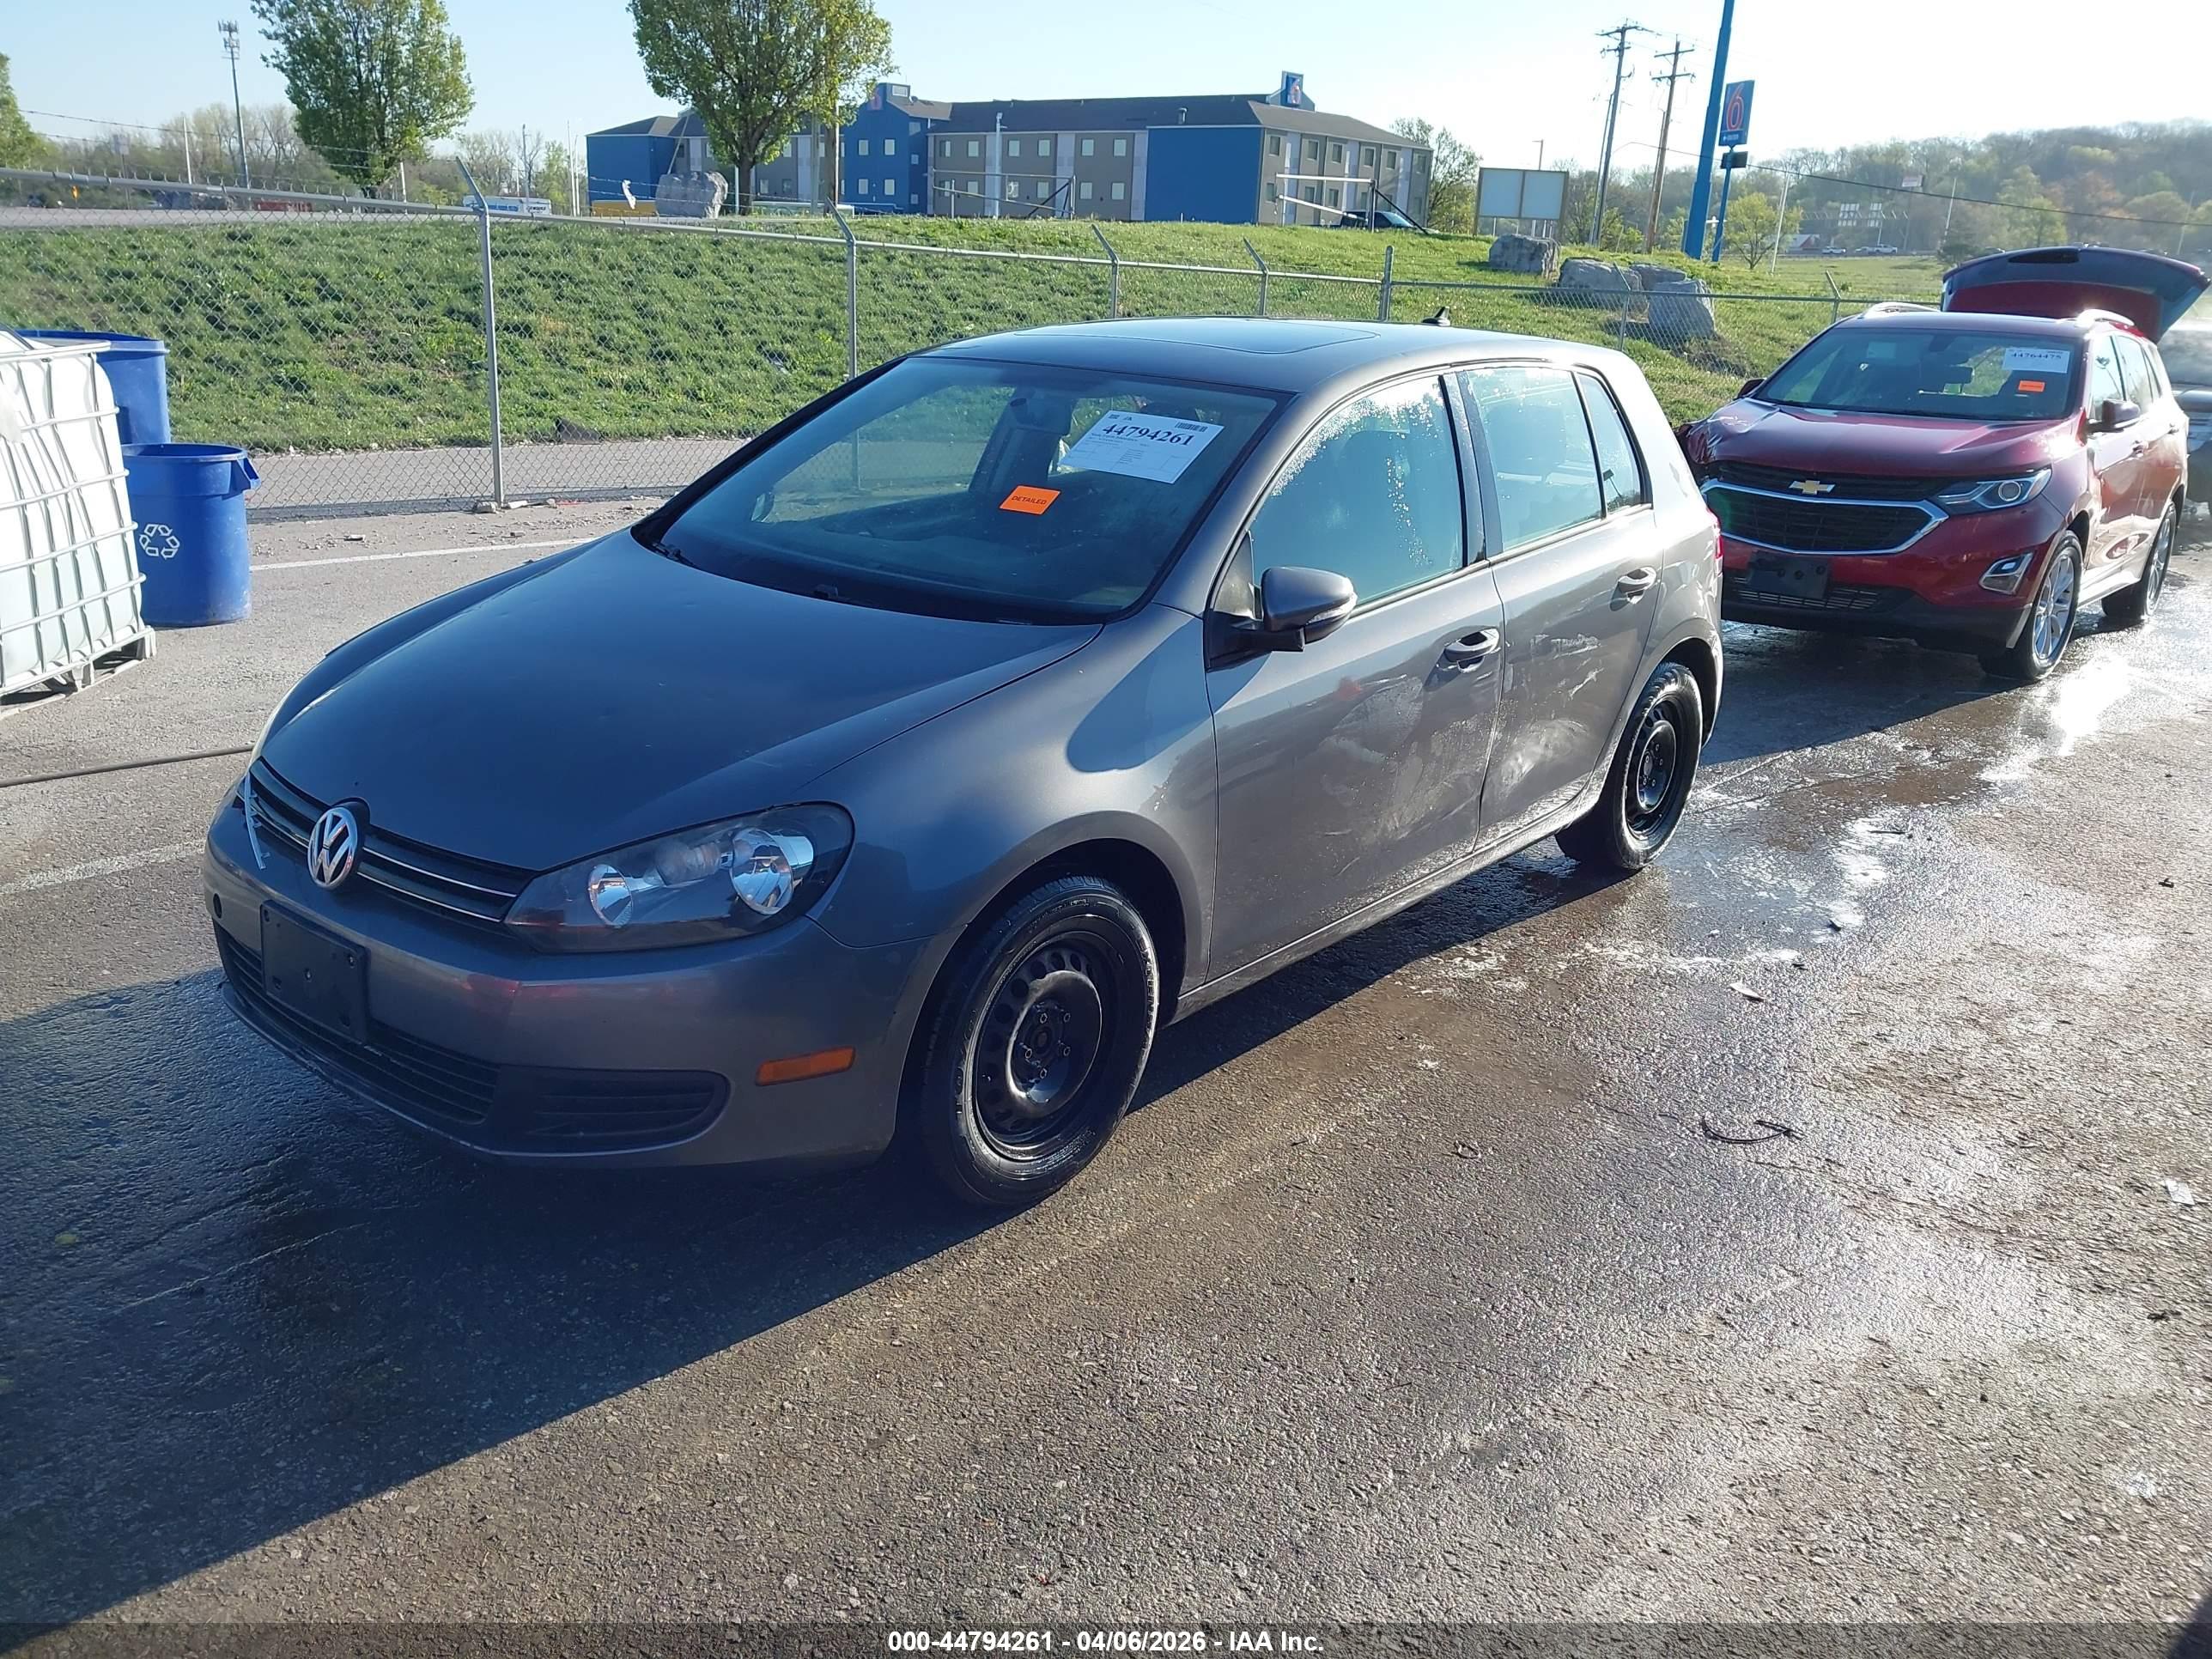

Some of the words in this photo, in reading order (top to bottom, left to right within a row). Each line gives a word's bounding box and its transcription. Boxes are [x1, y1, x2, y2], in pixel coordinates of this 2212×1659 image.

[1726, 82, 1744, 131] 6
[1103, 423, 1194, 447] 44794261
[1012, 495, 1048, 505] DETAILED
